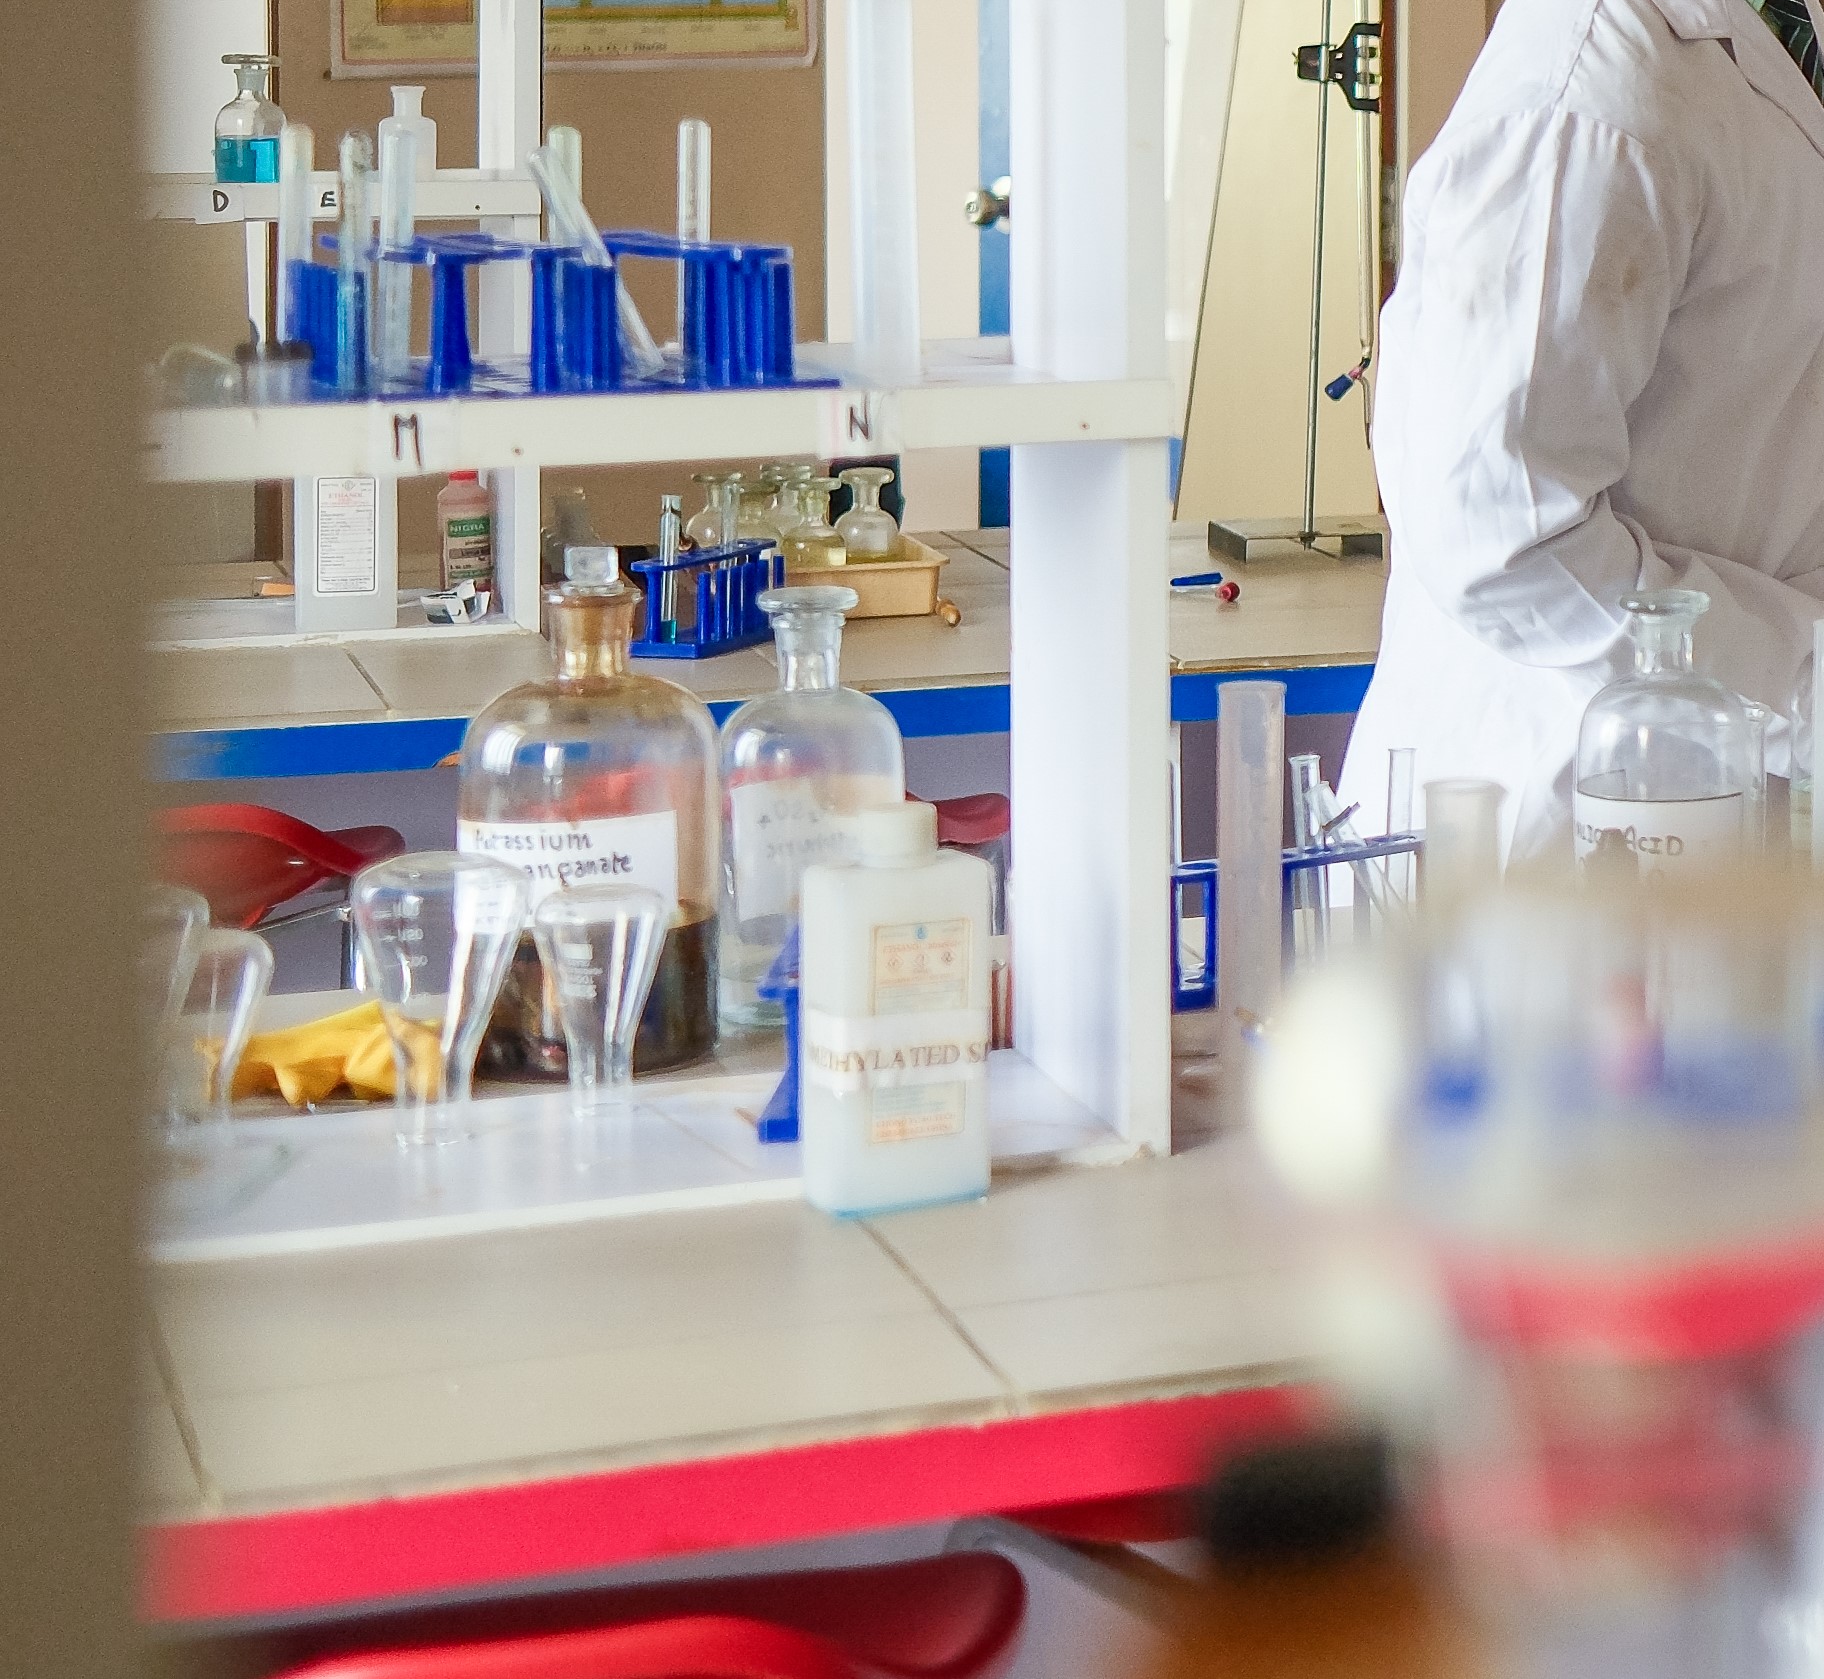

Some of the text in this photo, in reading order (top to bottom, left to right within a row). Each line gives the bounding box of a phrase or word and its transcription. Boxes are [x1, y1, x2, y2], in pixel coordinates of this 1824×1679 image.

[212, 189, 230, 213] D
[320, 190, 337, 208] E
[849, 393, 869, 441] N
[393, 413, 422, 467] M
[1624, 824, 1685, 856] ACID
